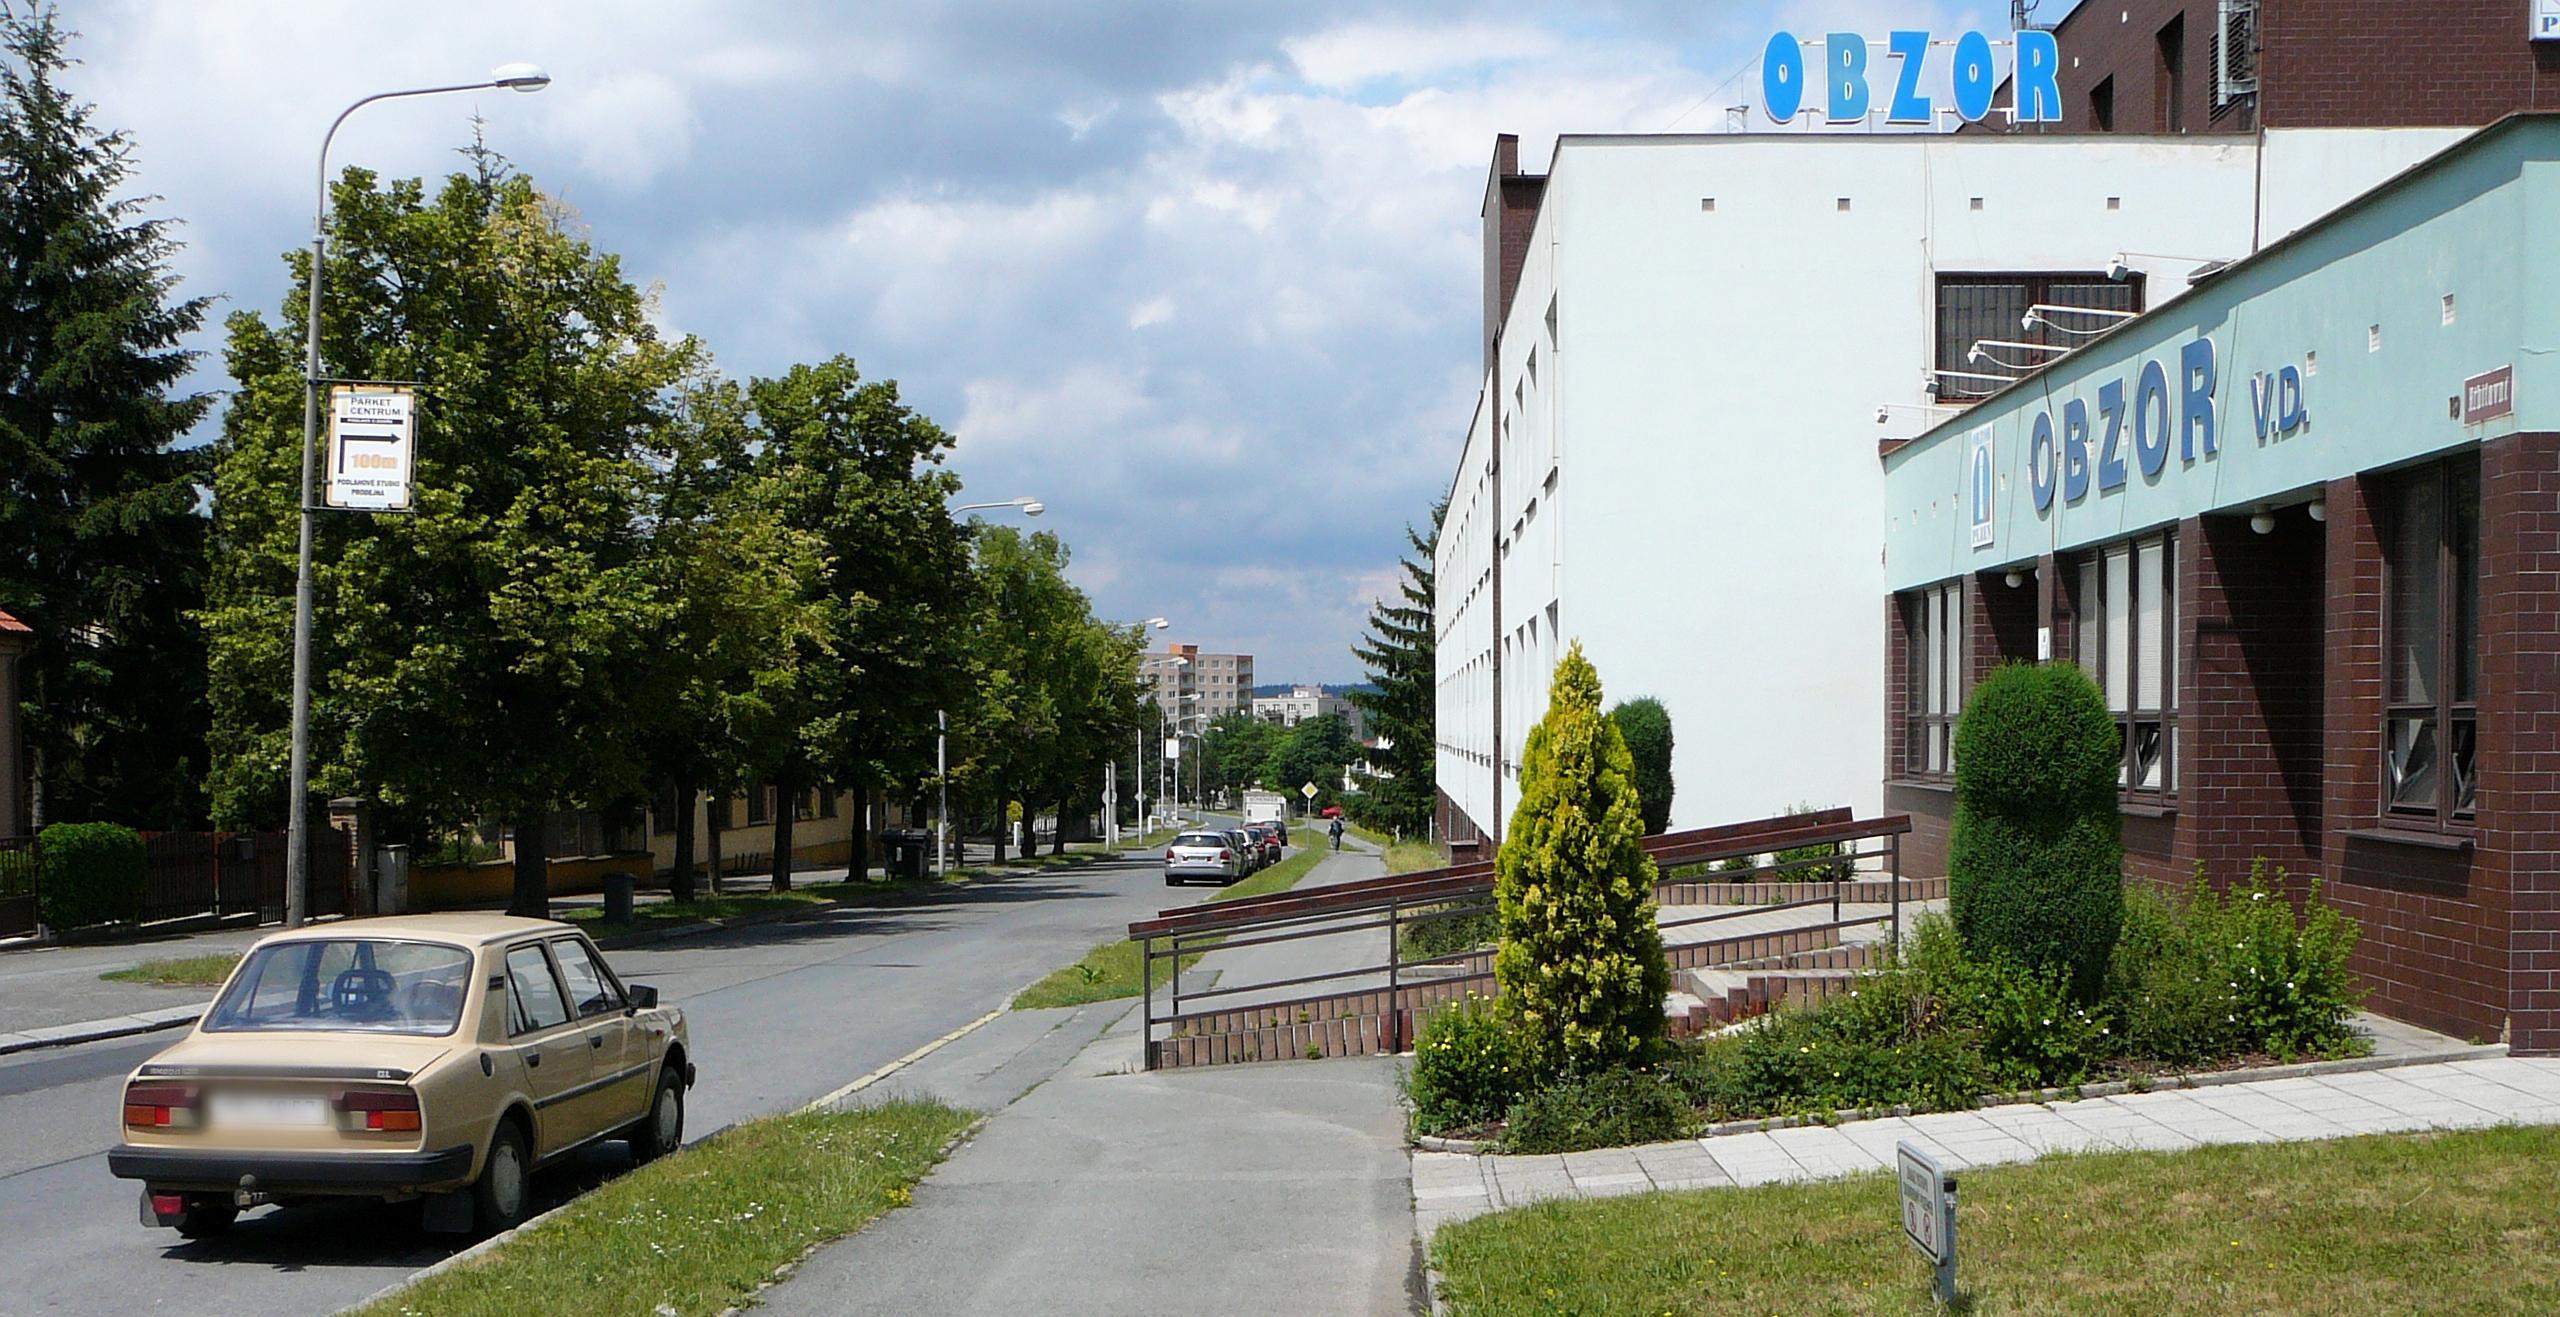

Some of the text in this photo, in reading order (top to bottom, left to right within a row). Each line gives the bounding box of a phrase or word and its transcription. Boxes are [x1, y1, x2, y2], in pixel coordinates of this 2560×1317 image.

[1762, 30, 2063, 124] OBZOR
[351, 397, 392, 407] PARKET
[350, 407, 401, 416] CENTRUM
[2031, 336, 2310, 512] OBZOR V.D.
[352, 454, 399, 469] 100m
